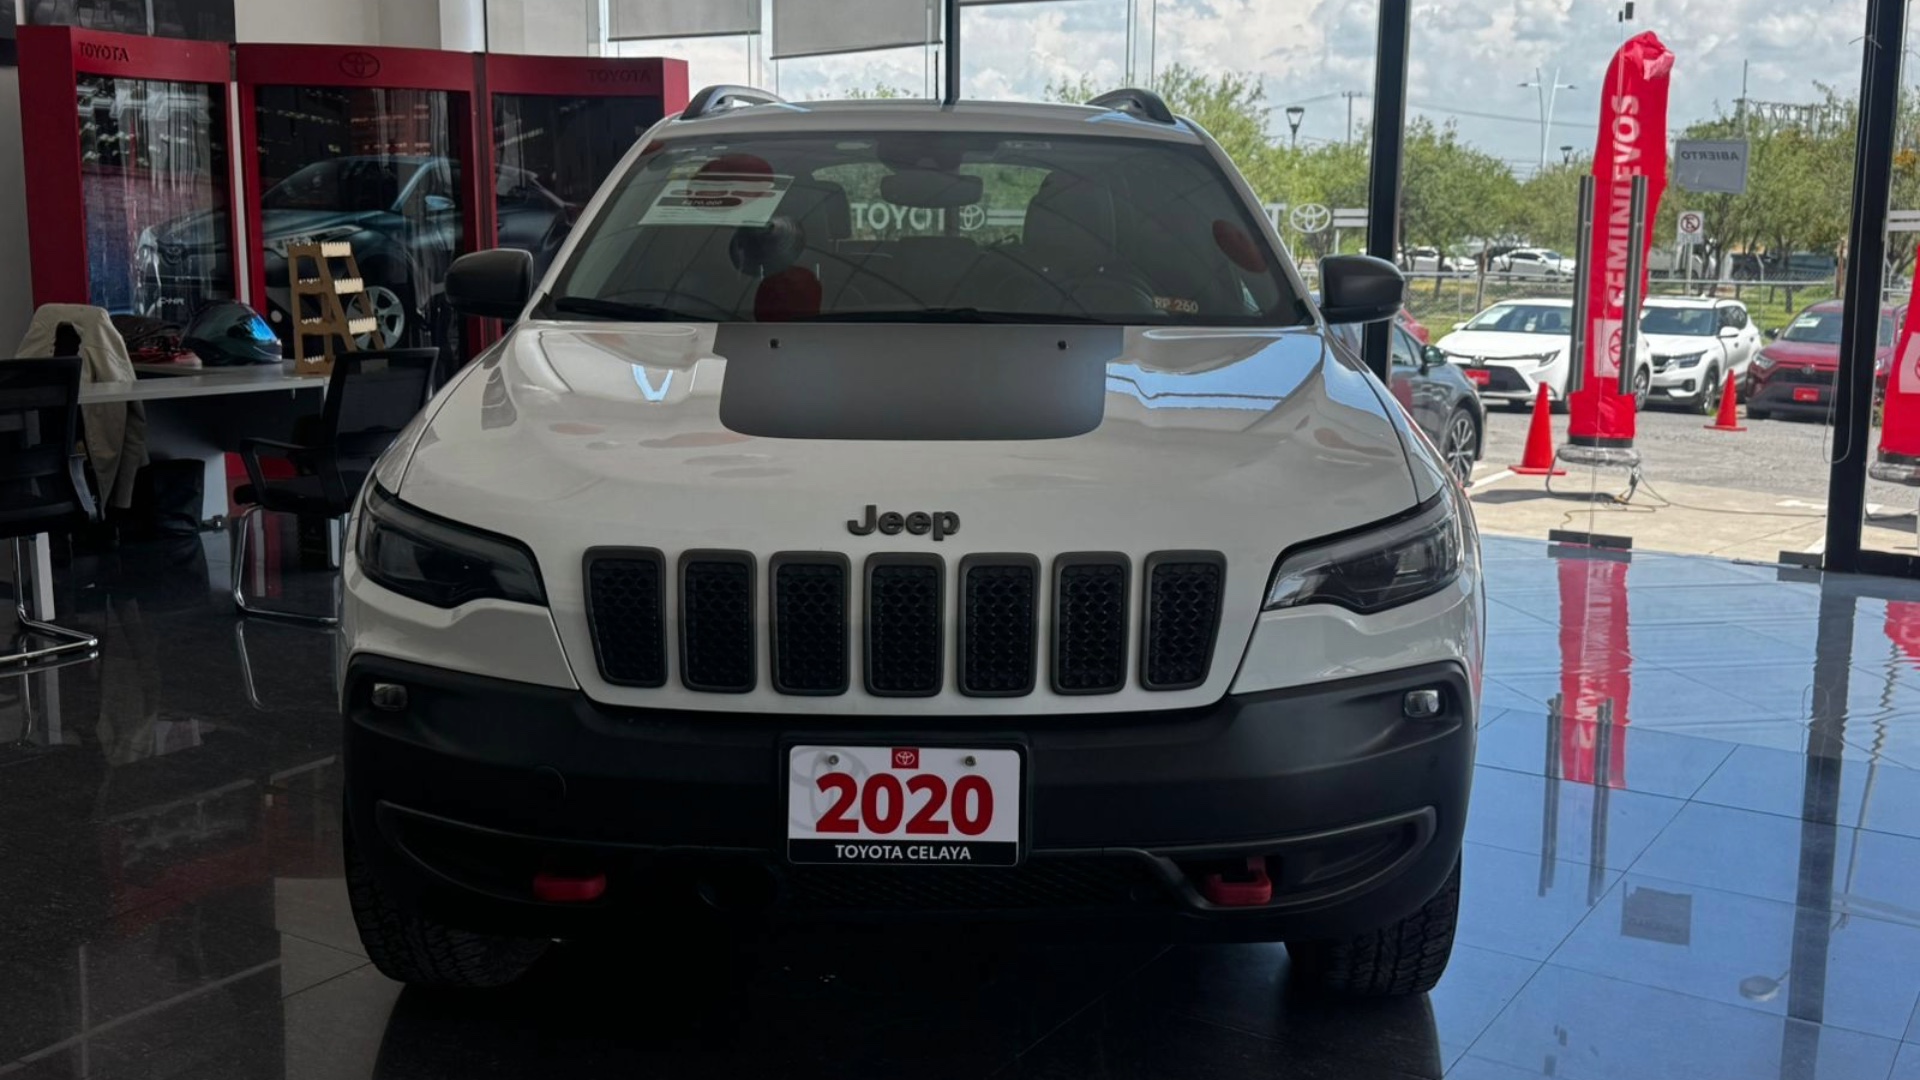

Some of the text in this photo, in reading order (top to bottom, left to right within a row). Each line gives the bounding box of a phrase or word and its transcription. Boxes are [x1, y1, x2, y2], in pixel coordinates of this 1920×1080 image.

[78, 41, 129, 62] TOYOTA
[586, 68, 652, 83] TOYOTA
[846, 504, 961, 542] Jeep
[815, 772, 994, 836] 2020
[835, 844, 971, 861] TOYOTA CELAYA
